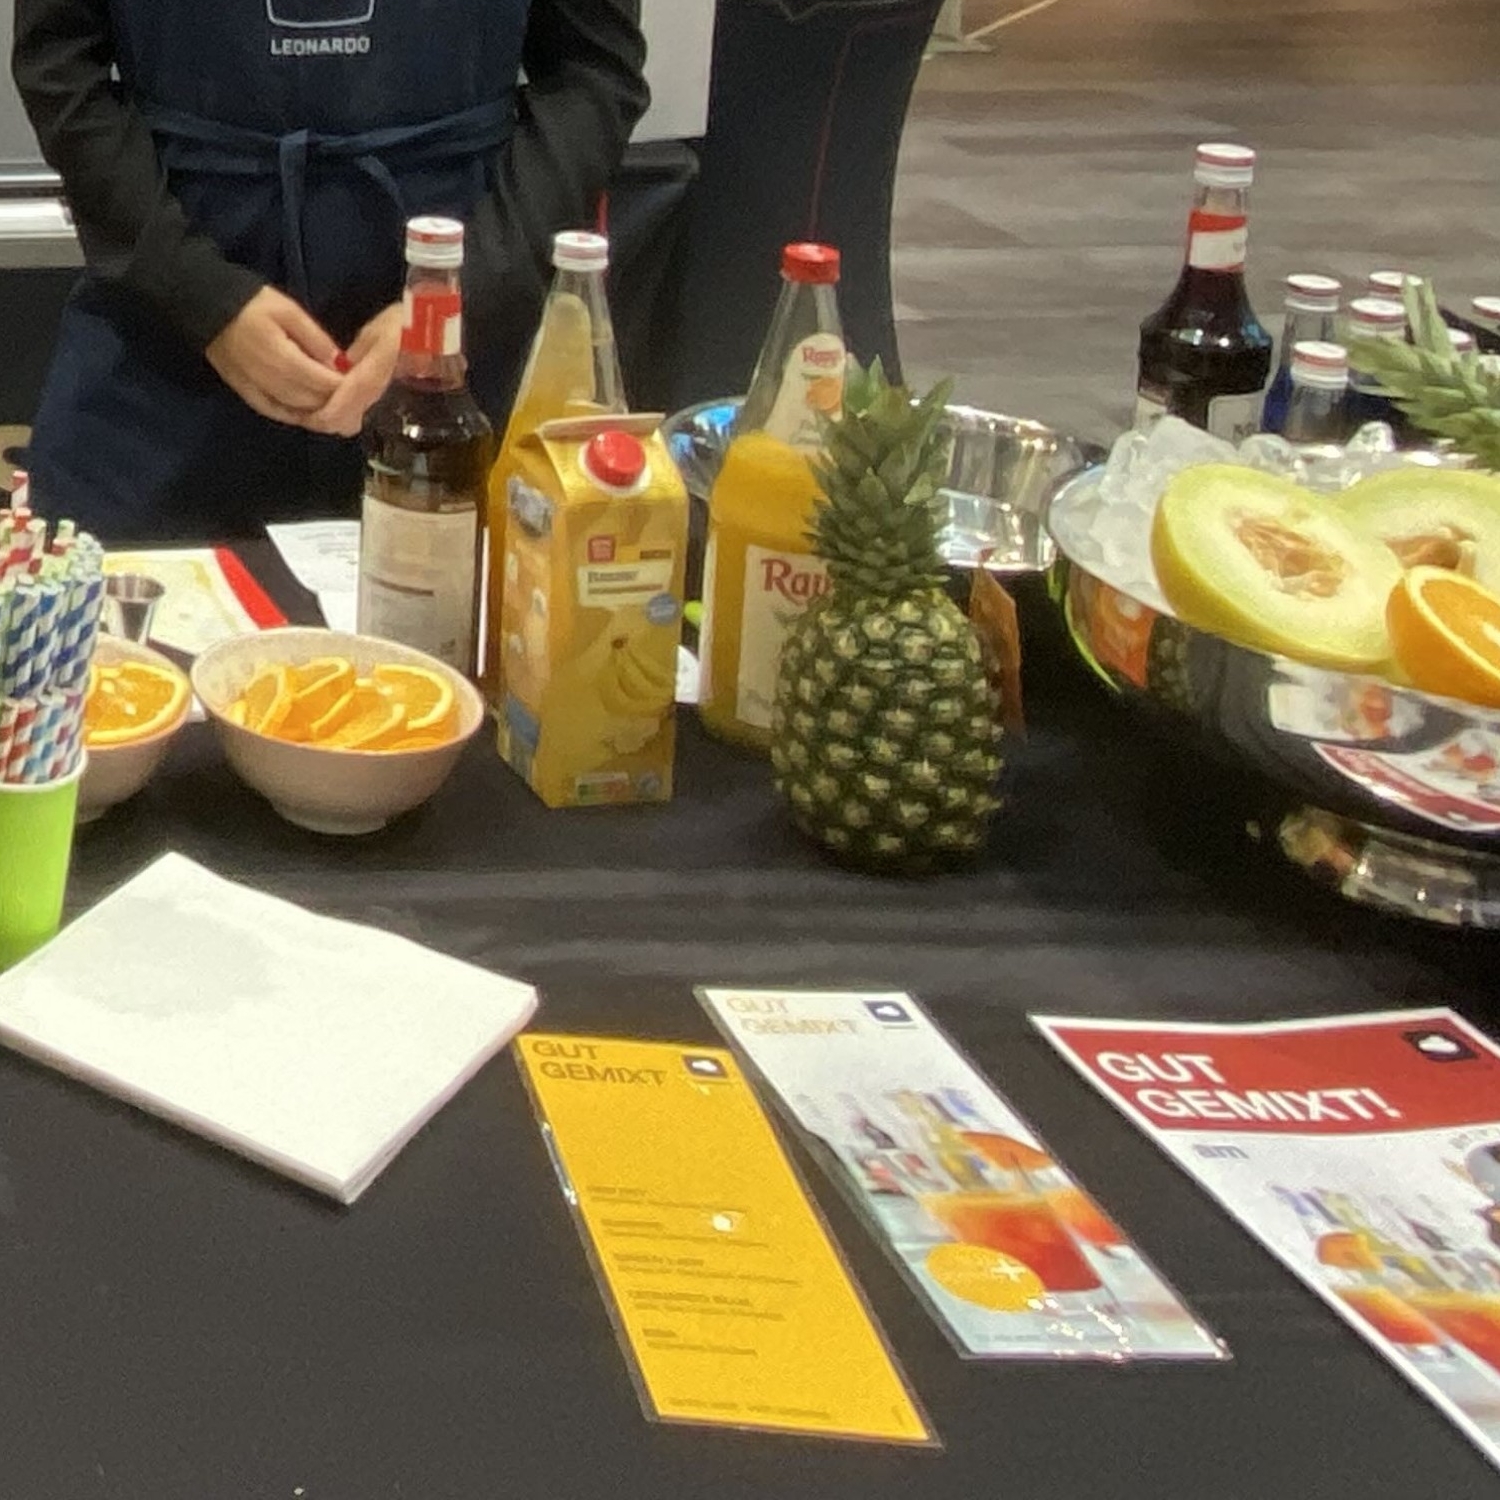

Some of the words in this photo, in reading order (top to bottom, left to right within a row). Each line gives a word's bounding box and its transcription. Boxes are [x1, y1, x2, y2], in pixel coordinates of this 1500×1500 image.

[270, 35, 371, 56] LEONARDO
[761, 558, 832, 606] Rap
[531, 1040, 599, 1061] GUT
[539, 1061, 669, 1087] GEMIXT
[1095, 1051, 1228, 1085] GUT
[1136, 1087, 1405, 1123] GEMIXT!
